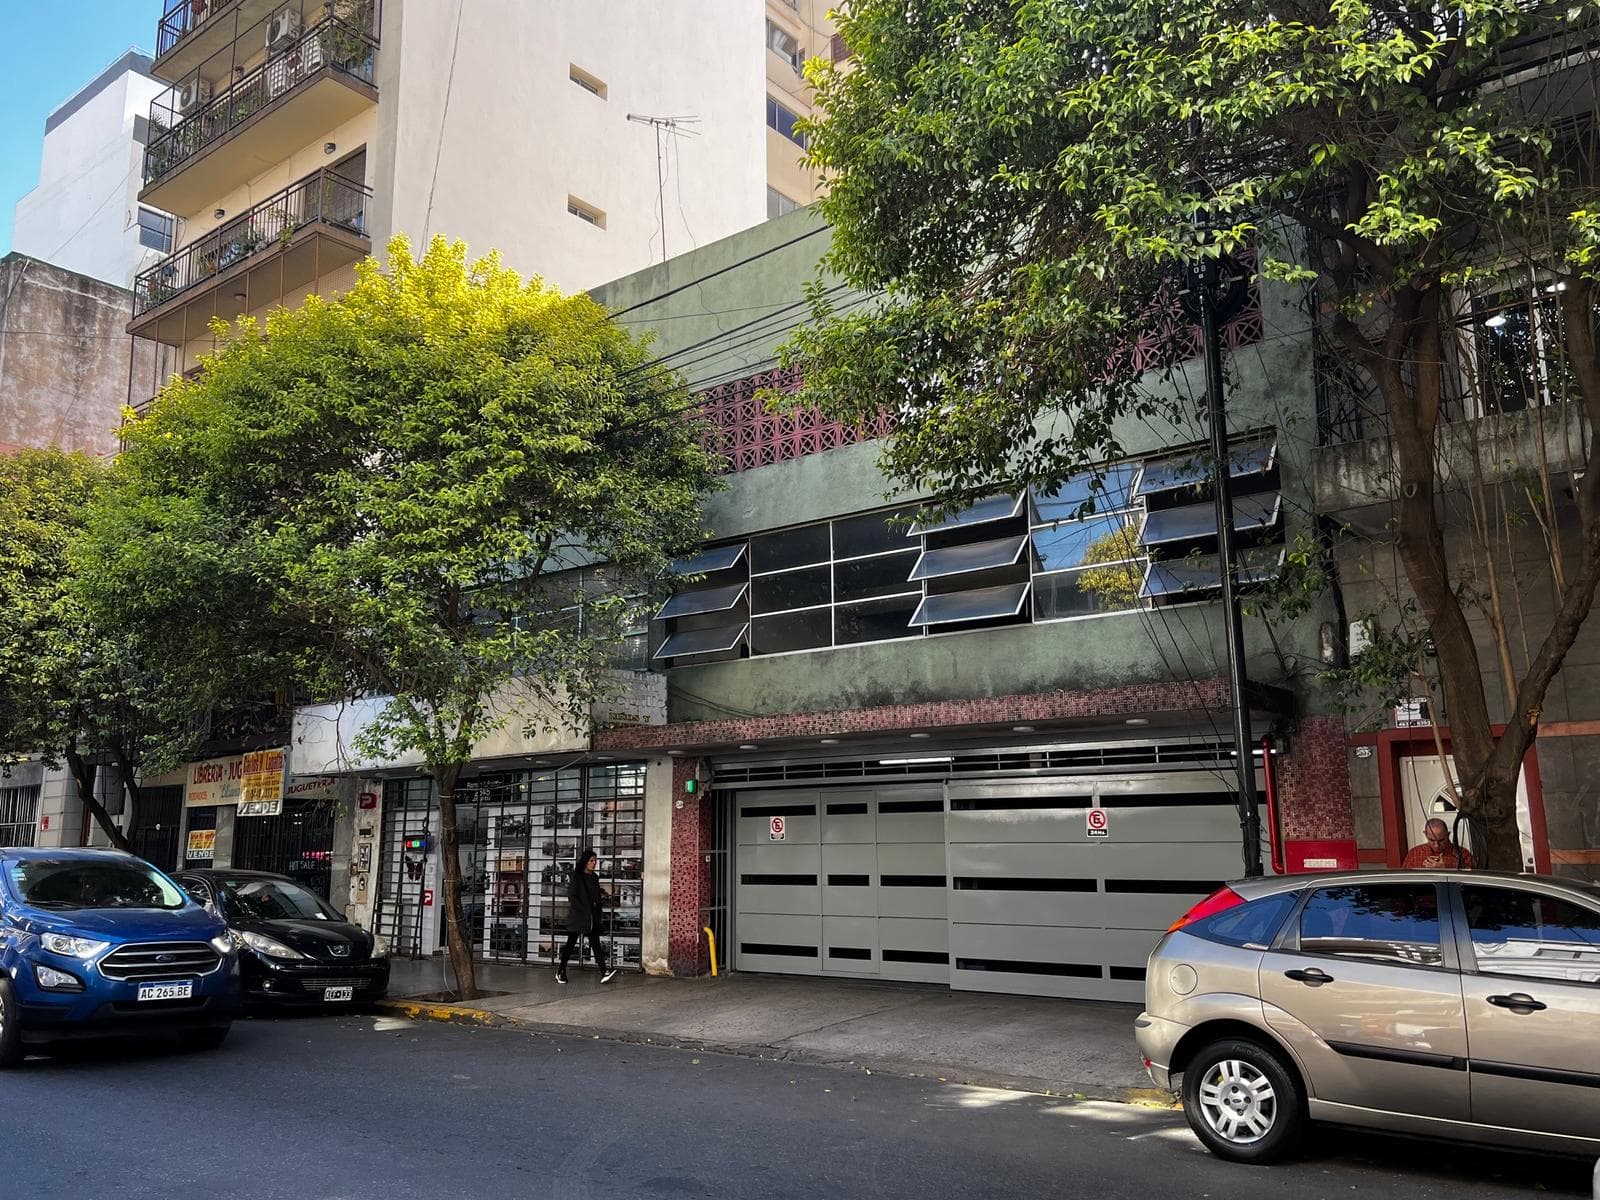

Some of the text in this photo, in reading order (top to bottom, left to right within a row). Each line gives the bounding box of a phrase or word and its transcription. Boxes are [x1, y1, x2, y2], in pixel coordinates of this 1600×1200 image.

[141, 986, 190, 999] AC 265 BE
